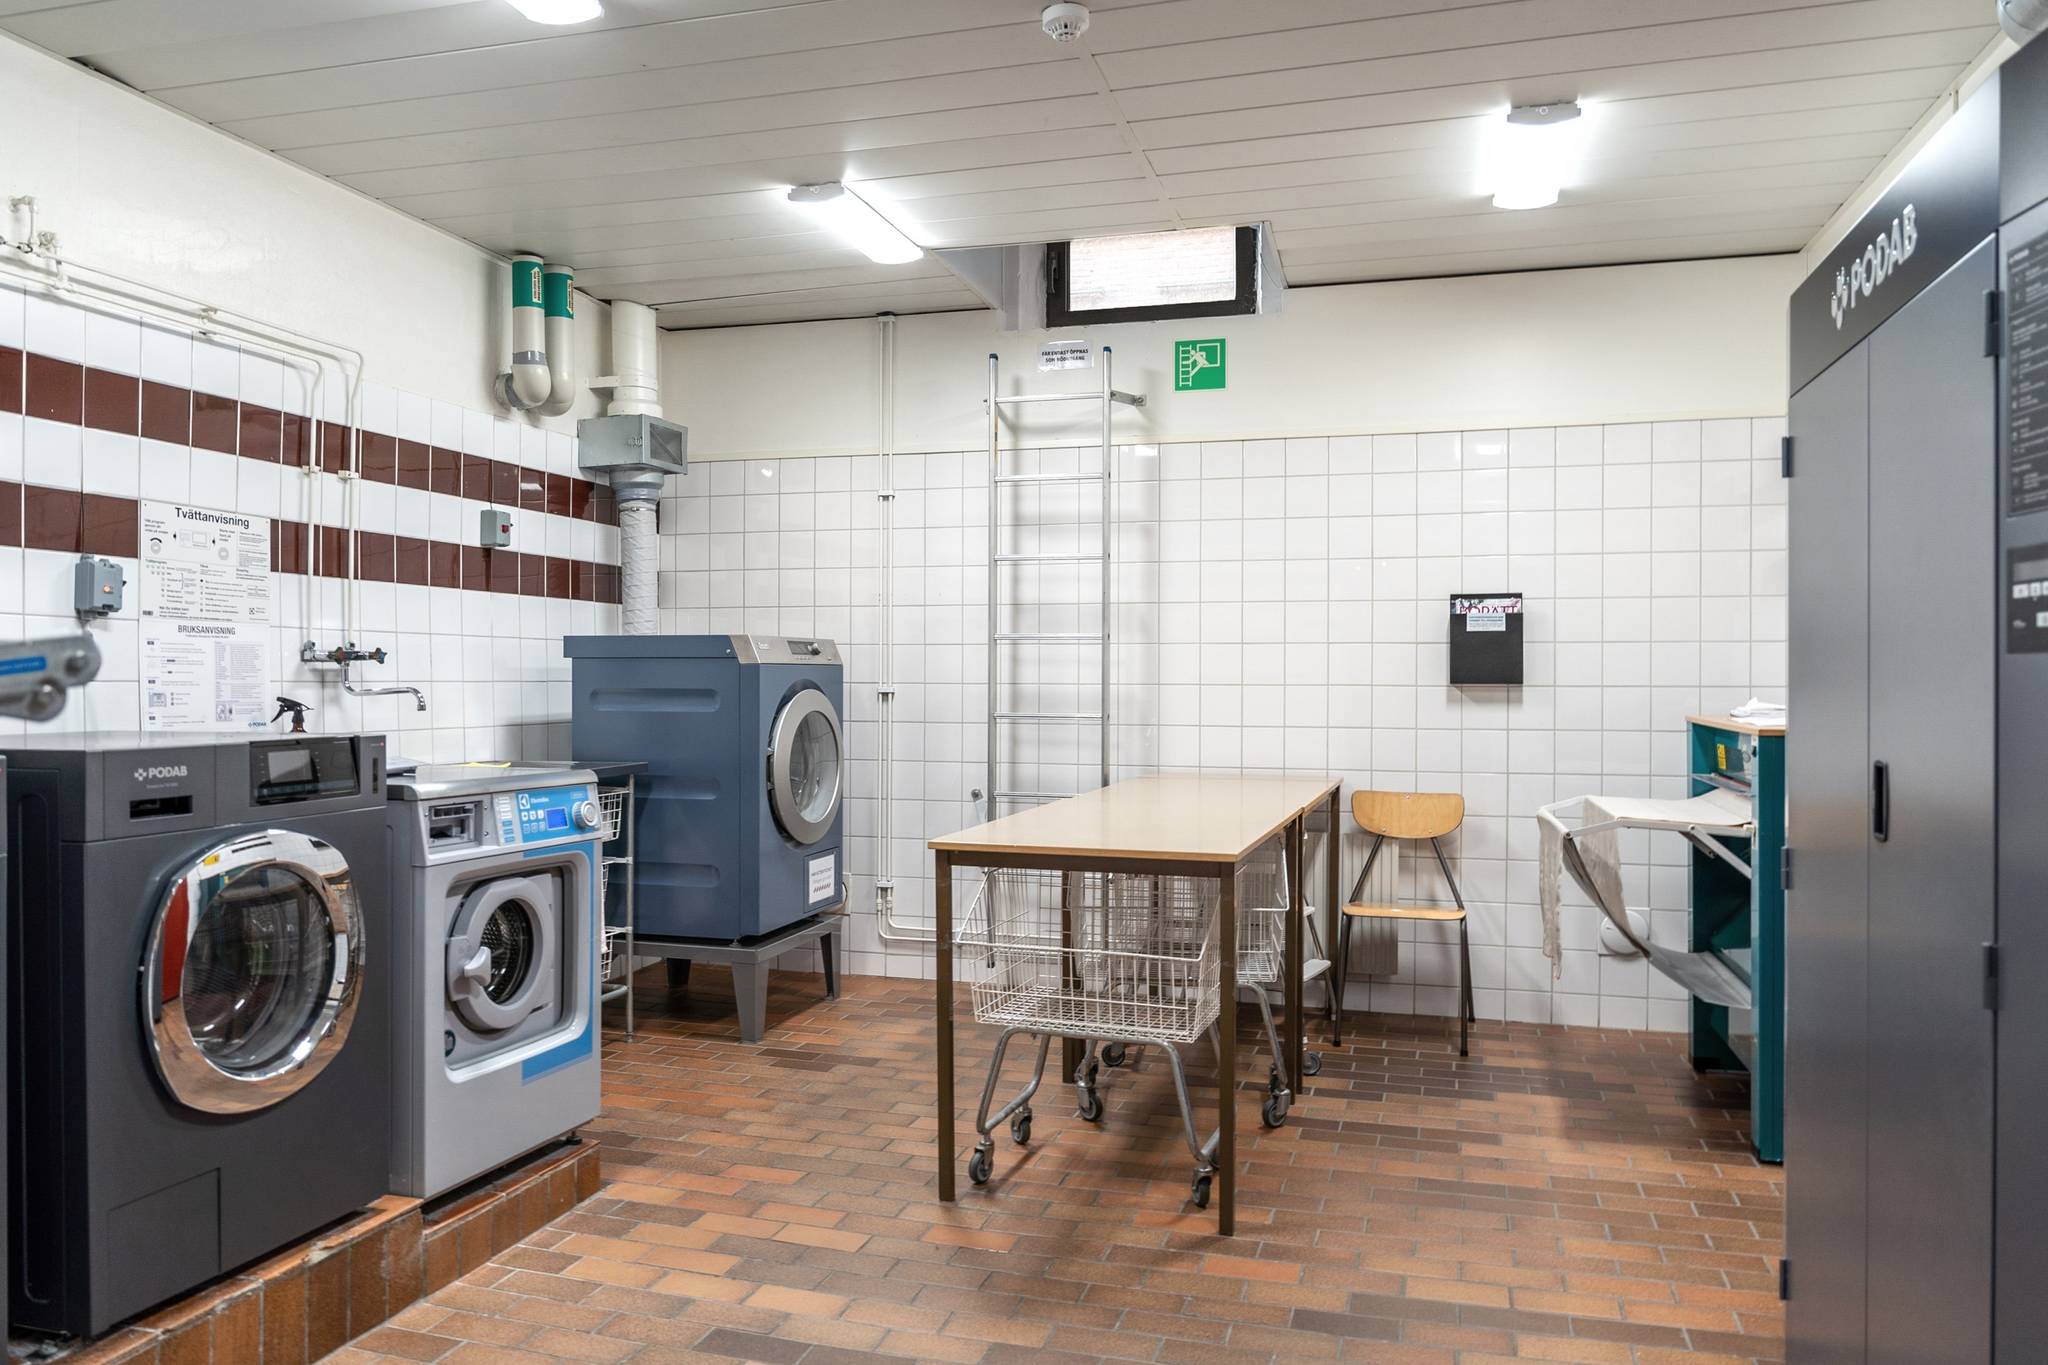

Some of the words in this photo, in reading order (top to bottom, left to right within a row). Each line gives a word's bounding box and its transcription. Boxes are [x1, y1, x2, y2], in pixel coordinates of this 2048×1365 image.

[1850, 203, 1918, 309] PODAB
[174, 506, 250, 530] Tvättanvisning
[177, 624, 236, 636] BRUKSANVISNING
[148, 765, 188, 779] PODAB
